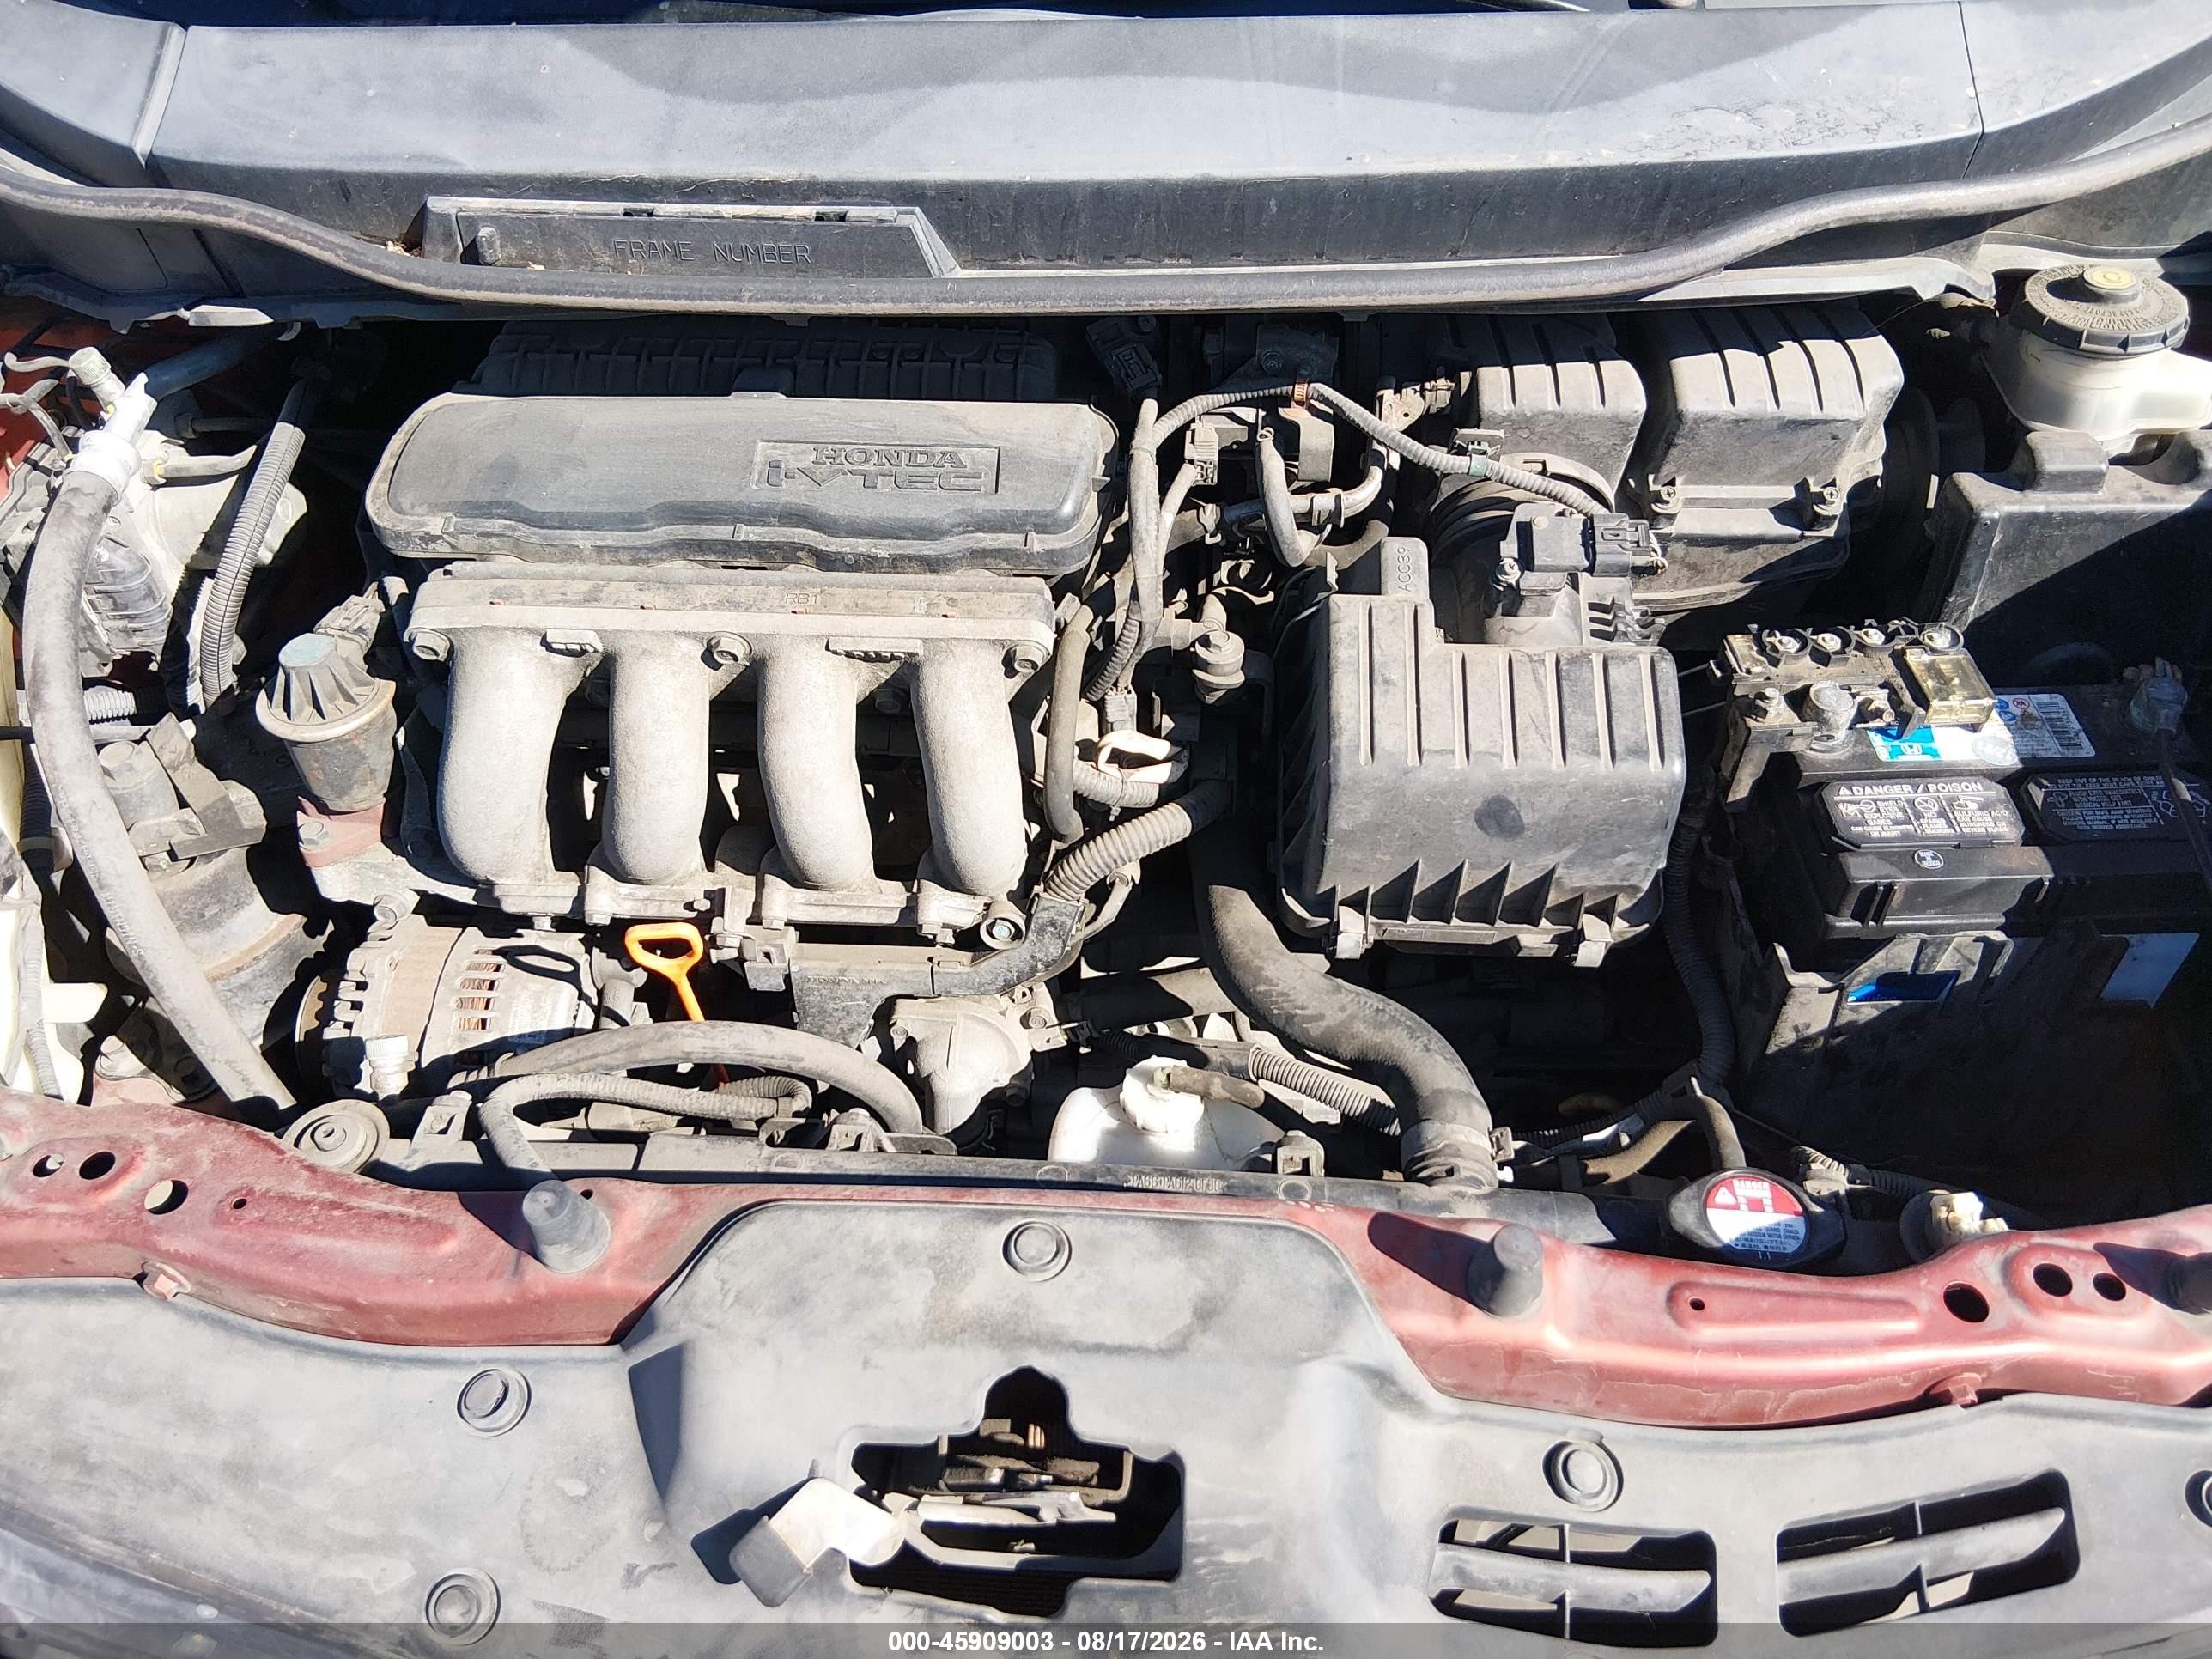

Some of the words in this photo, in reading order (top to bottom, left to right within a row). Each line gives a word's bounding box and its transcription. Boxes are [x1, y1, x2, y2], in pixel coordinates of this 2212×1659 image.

[612, 240, 695, 261] FRAME
[713, 241, 812, 264] NUMBER
[812, 447, 967, 469] HONDA
[785, 592, 818, 605] RB1
[1851, 784, 1913, 795] DANGER
[1928, 782, 1984, 793] POISON
